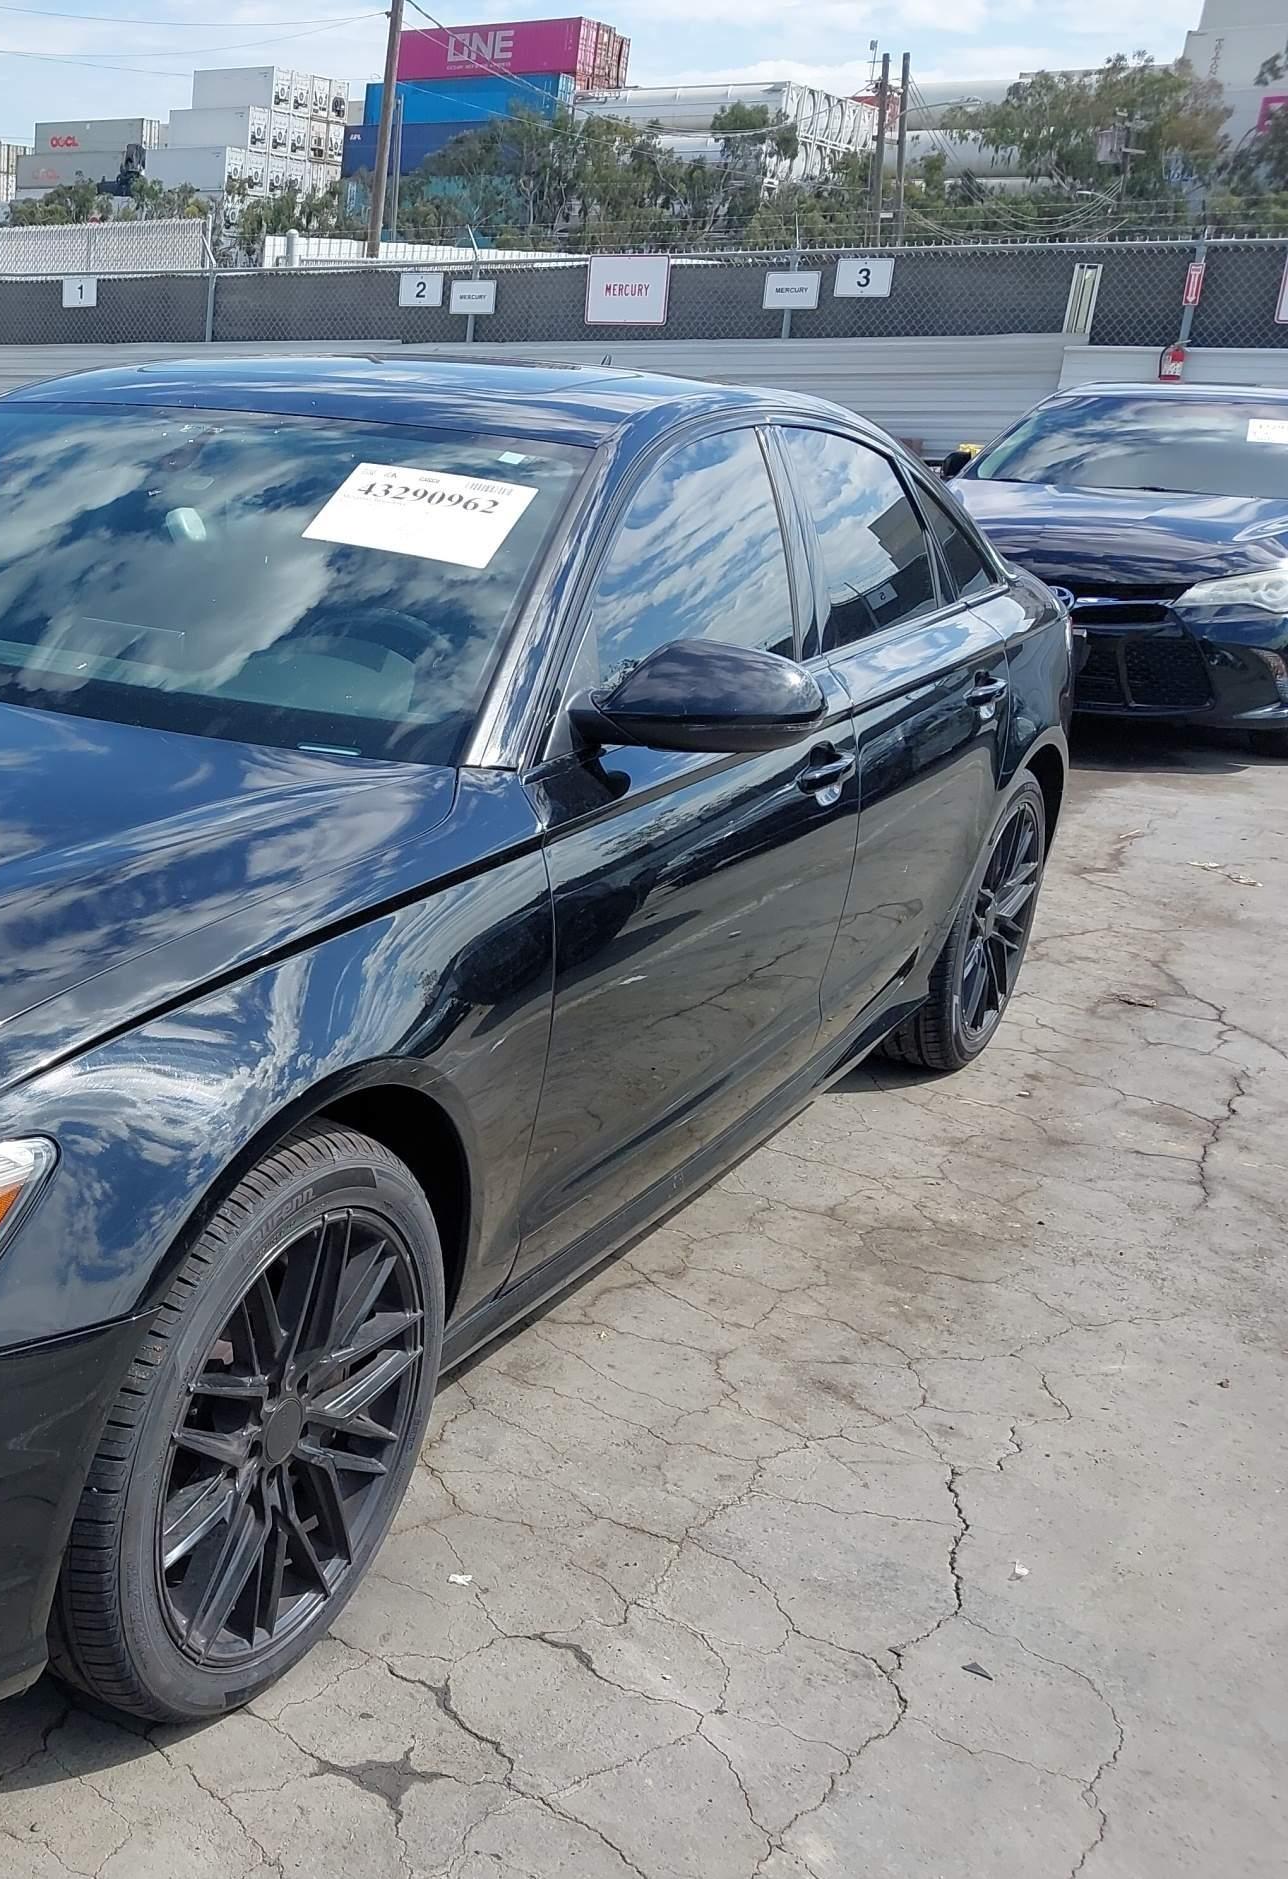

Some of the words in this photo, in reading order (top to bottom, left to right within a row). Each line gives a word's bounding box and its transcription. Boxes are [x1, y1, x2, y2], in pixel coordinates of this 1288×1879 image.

[448, 30, 514, 61] ONE
[856, 268, 871, 287] 3
[77, 284, 83, 299] 1
[415, 281, 427, 298] 2
[604, 283, 650, 296] MERCURY
[357, 482, 499, 514] 43290962
